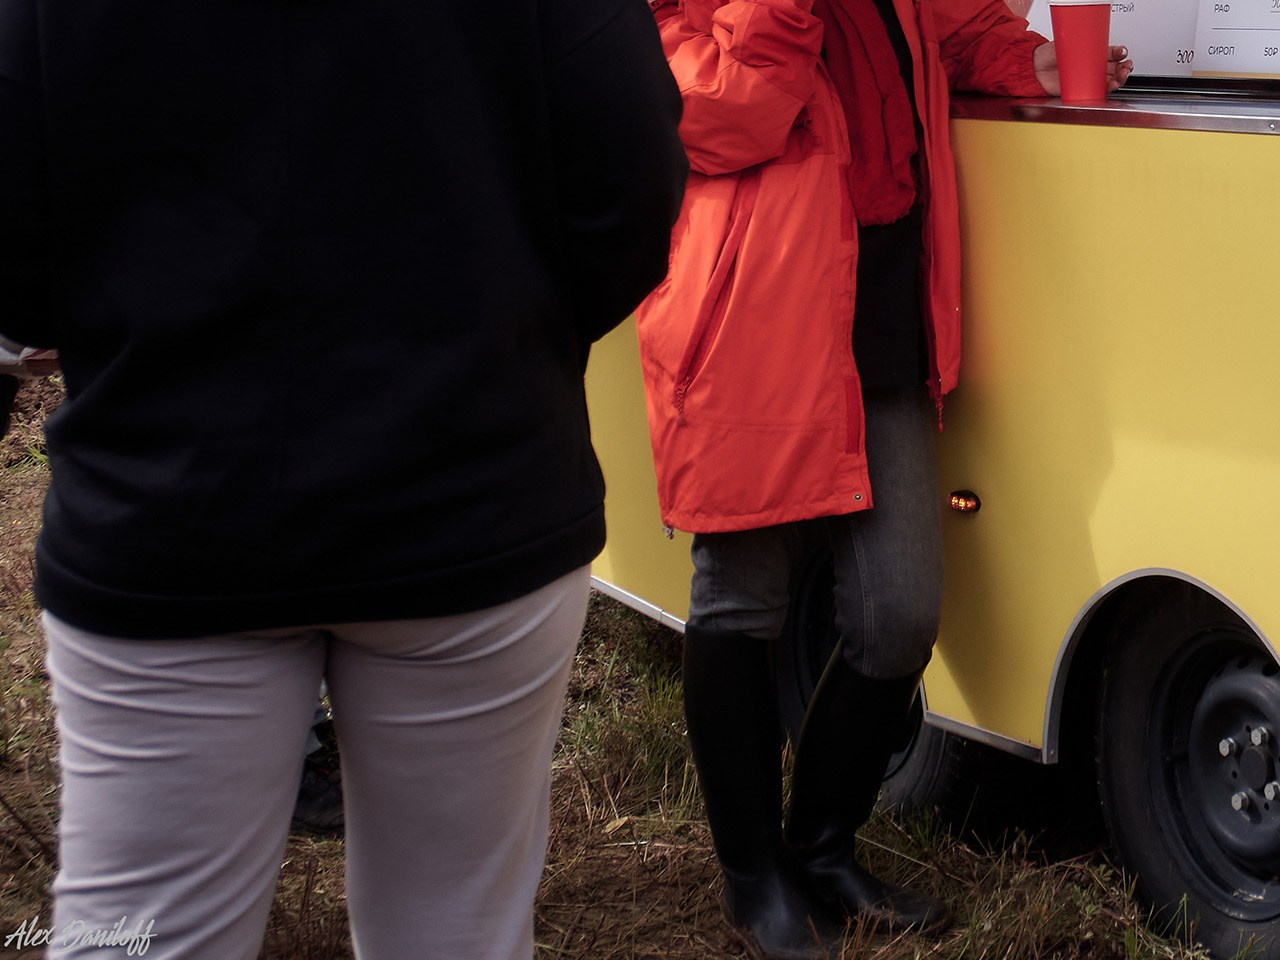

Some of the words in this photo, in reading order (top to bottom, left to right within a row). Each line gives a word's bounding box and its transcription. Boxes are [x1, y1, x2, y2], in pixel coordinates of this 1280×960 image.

[1111, 3, 1135, 13] СТРЫЙ
[1214, 4, 1230, 13] РАФ
[1208, 46, 1235, 56] СИРОП
